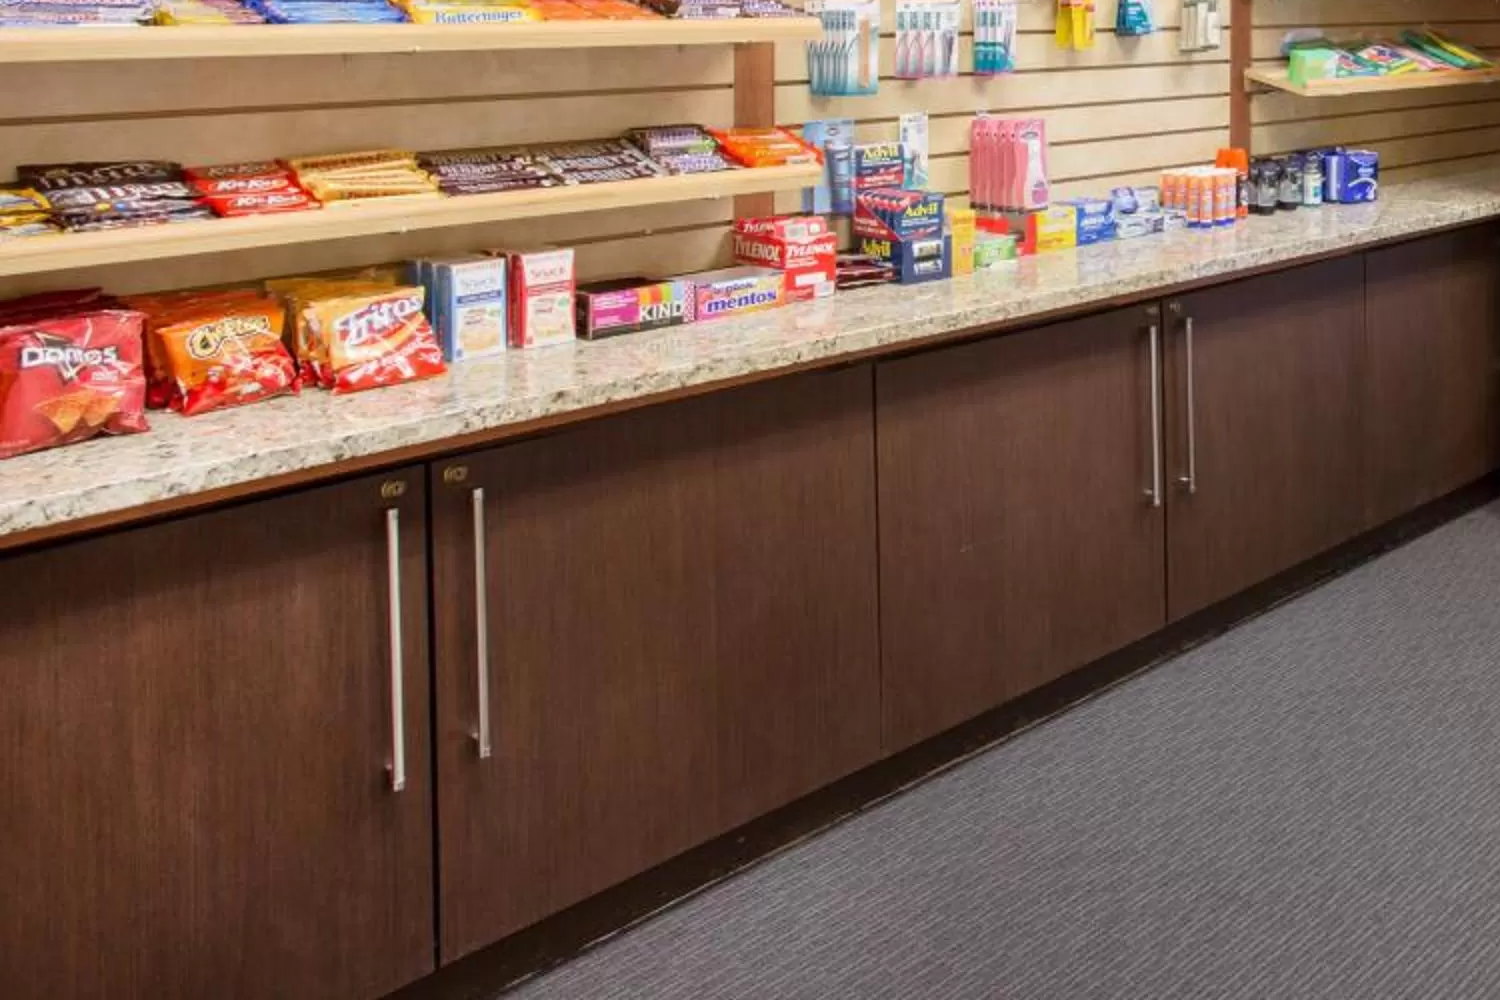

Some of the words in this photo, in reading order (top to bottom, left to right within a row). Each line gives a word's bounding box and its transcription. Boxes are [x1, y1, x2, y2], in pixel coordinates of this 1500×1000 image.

[904, 201, 938, 217] Advil
[707, 290, 777, 313] mentos
[639, 302, 684, 322] KIND
